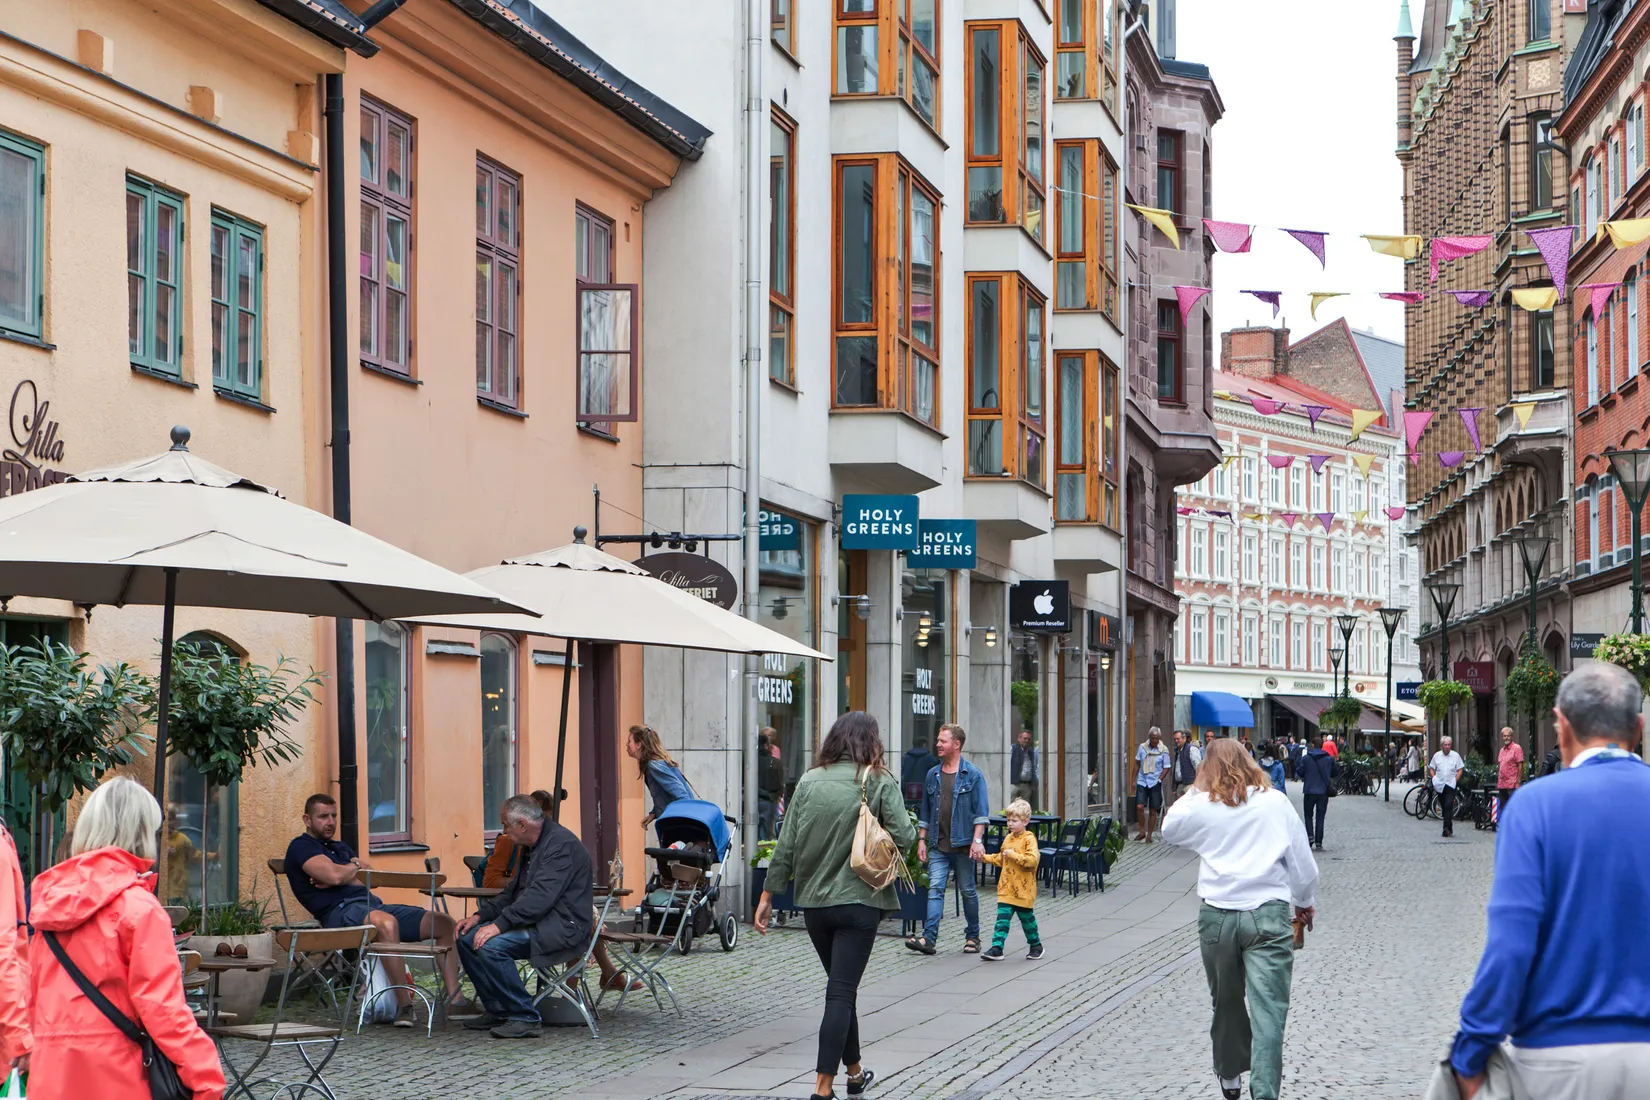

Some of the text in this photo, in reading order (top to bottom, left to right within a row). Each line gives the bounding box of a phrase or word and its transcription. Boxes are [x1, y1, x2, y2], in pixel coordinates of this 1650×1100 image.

[860, 509, 903, 521] HOLY
[847, 523, 913, 535] GREENS
[923, 532, 963, 543] HOLY
[911, 545, 972, 556] GREENS
[764, 653, 788, 672] HOLY
[916, 667, 933, 690] HOLY
[757, 676, 793, 704] GREENS
[912, 693, 936, 716] GREENS
